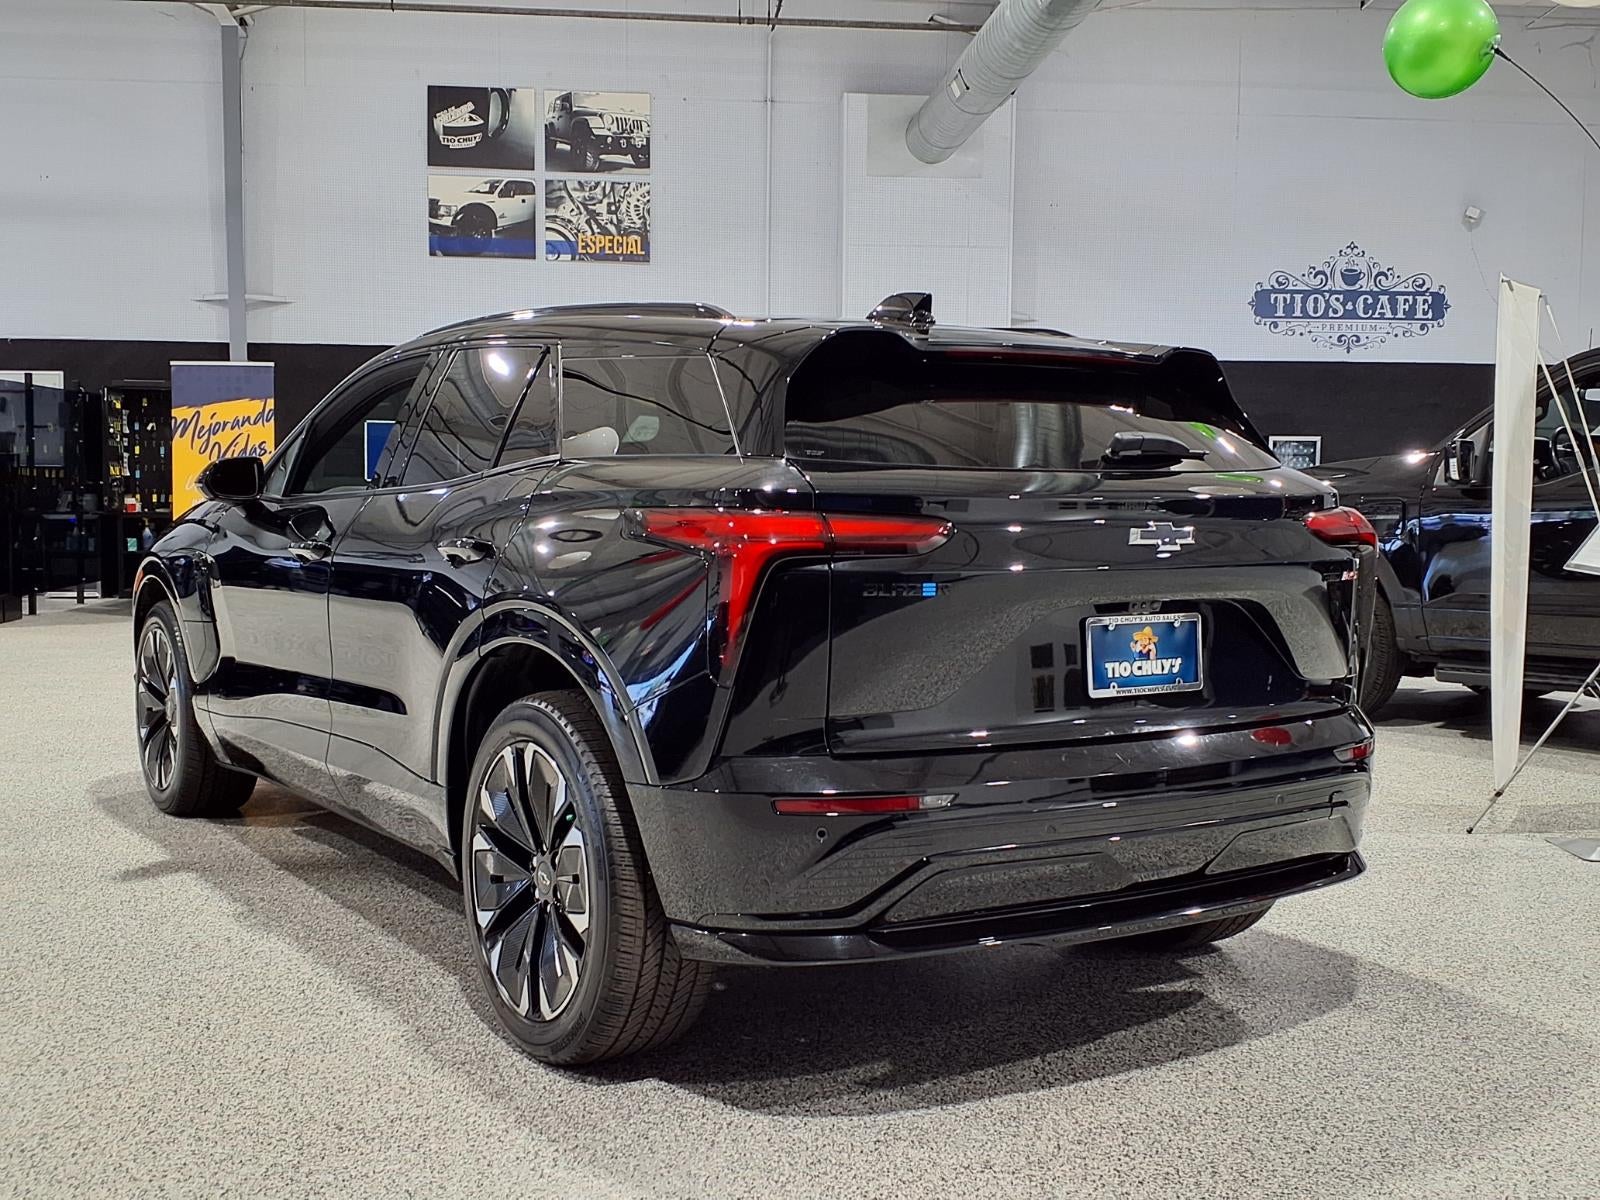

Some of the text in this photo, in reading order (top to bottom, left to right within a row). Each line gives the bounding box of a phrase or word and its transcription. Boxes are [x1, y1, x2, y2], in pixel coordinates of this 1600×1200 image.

[578, 234, 645, 255] ESPECIAL
[1270, 292, 1344, 318] TIO'S
[1321, 323, 1379, 332] PREMIUM
[1105, 658, 1181, 678] TIO CHUY'S
